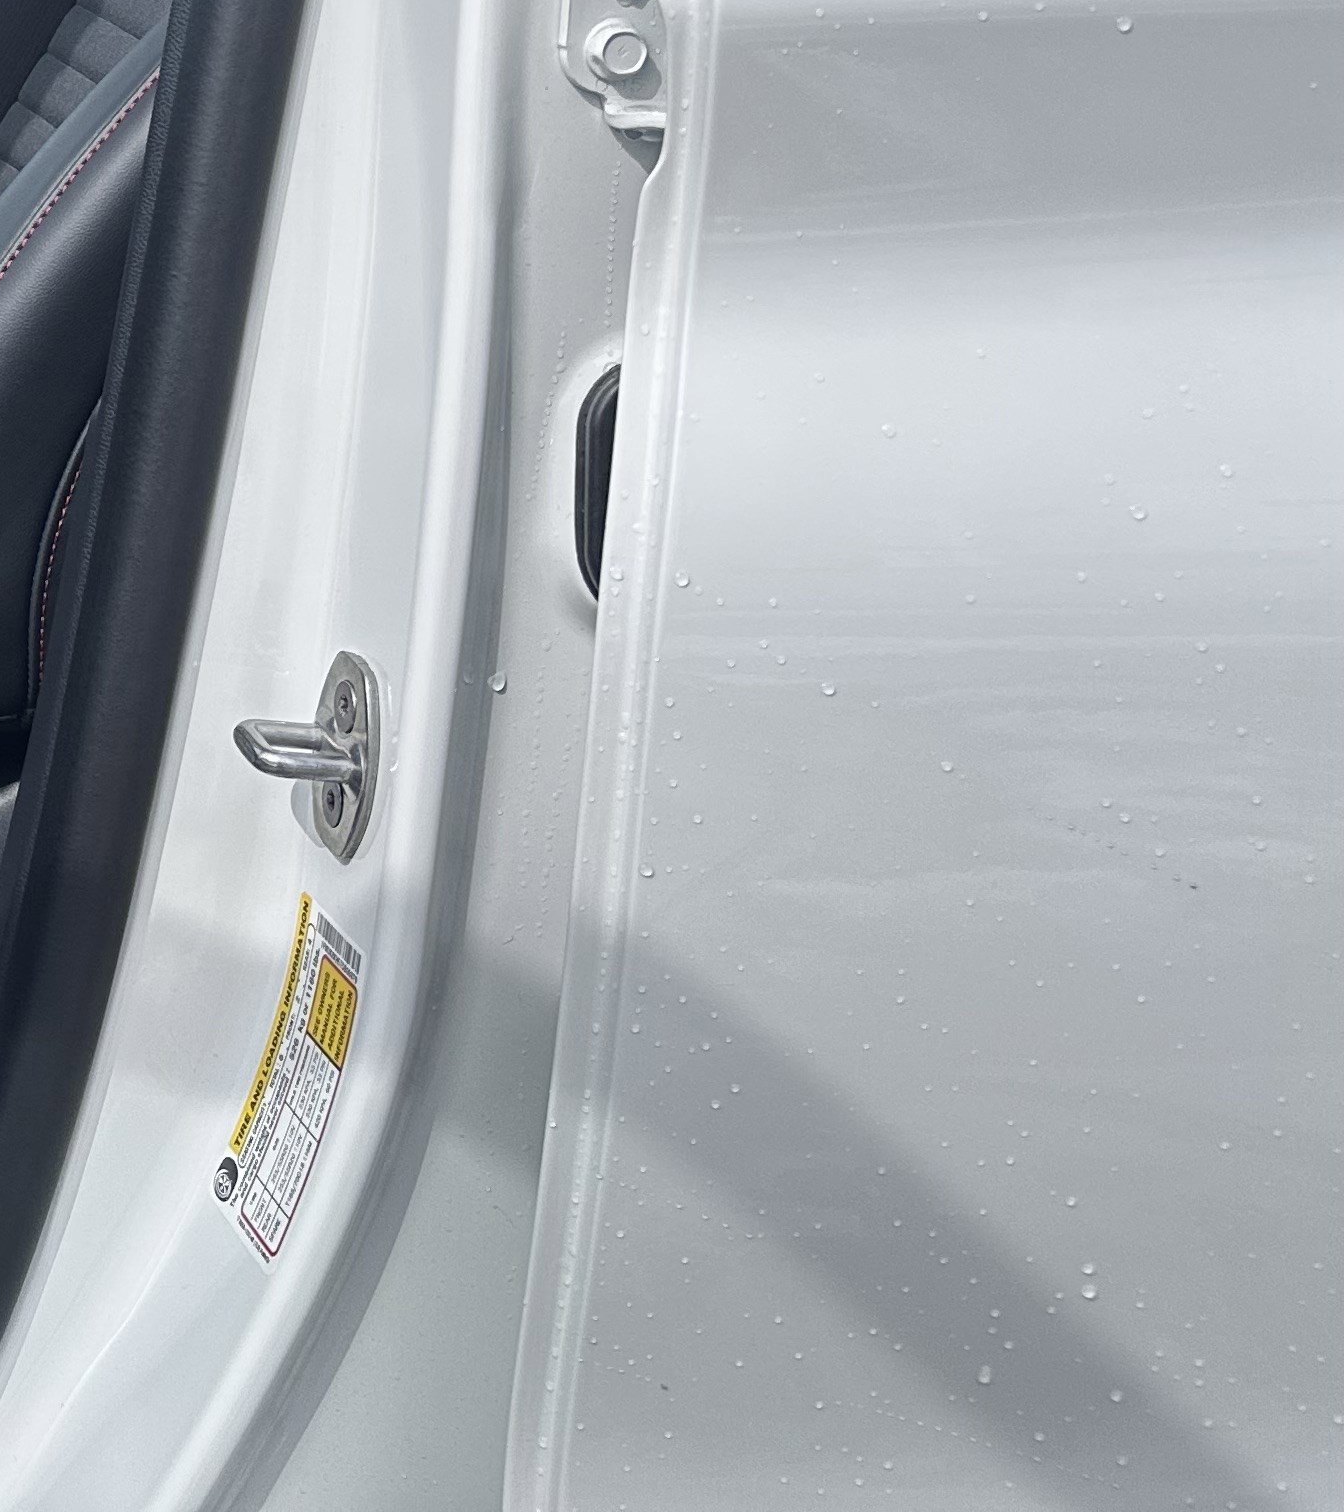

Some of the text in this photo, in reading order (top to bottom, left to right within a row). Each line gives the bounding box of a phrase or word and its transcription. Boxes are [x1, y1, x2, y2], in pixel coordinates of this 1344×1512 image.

[233, 898, 309, 1151] TIRE AND LOADING INFORMATION
[297, 1015, 306, 1035] kg
[302, 1001, 309, 1016] or
[311, 1014, 320, 1038] SEE
[318, 977, 338, 1046] MANUAL FOR
[326, 987, 344, 1051] ADDITIONAL
[332, 988, 353, 1063] INFORMATION
[229, 1190, 238, 1210] The
